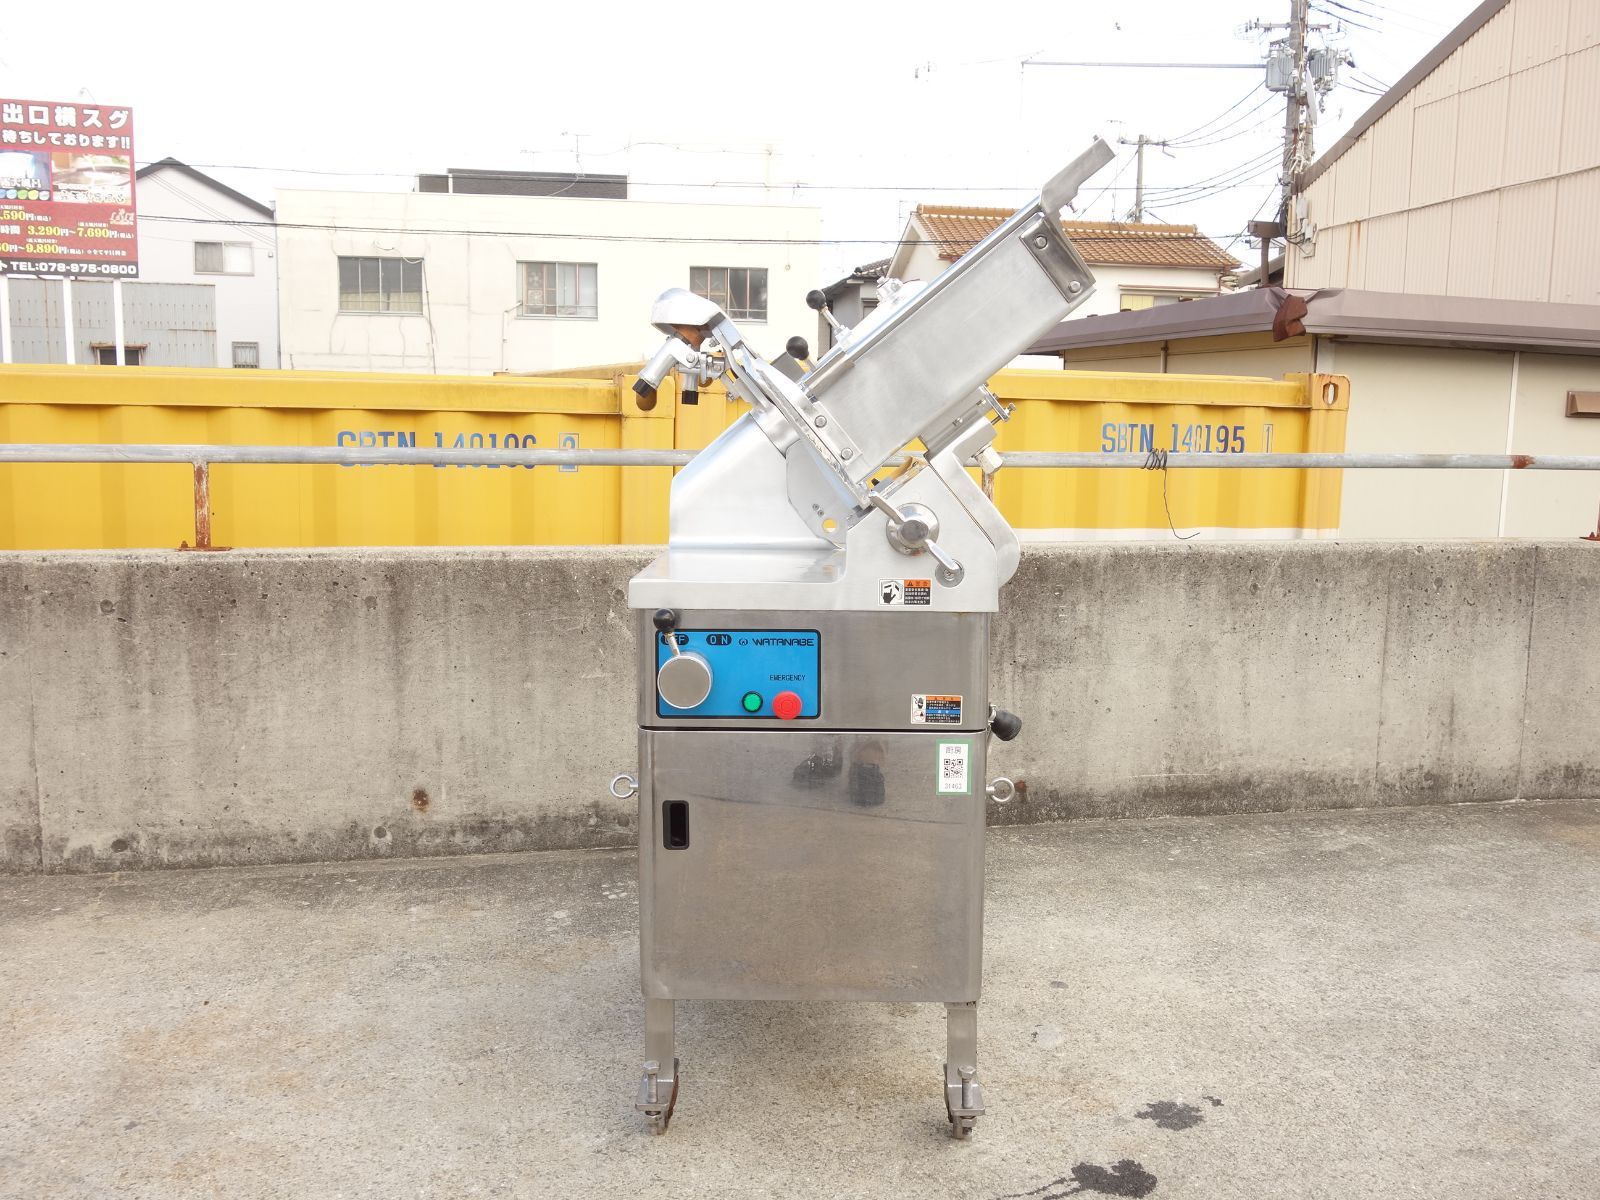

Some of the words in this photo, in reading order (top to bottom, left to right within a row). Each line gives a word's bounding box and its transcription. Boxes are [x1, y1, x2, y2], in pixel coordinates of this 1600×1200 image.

[2, 102, 129, 129] 出口横スグ
[1102, 422, 1155, 453] SBTN
[1168, 423, 1245, 454] 140195
[752, 638, 815, 647] WATANABE
[769, 674, 806, 682] EMERGENCY
